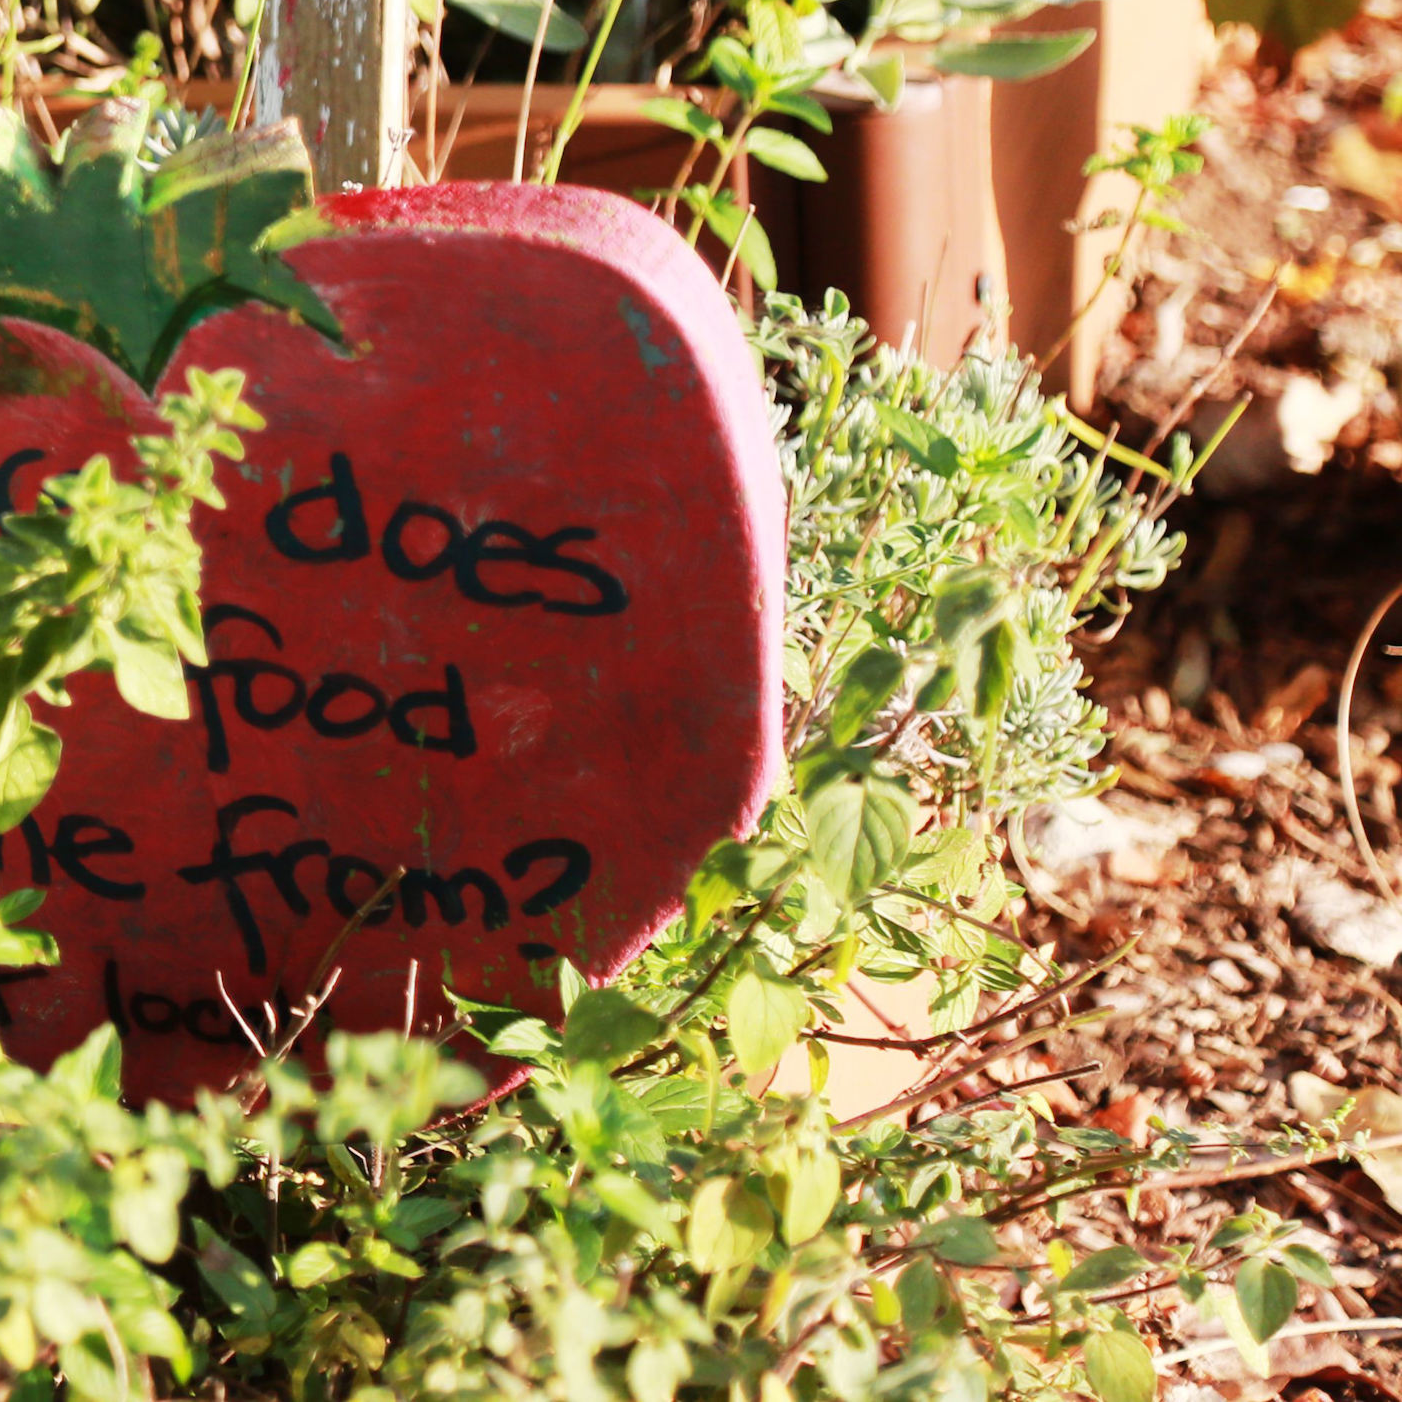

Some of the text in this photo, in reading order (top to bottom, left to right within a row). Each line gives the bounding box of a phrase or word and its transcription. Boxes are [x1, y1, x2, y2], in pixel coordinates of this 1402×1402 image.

[265, 451, 629, 616] does
[184, 603, 477, 773] food
[176, 795, 591, 976] from?
